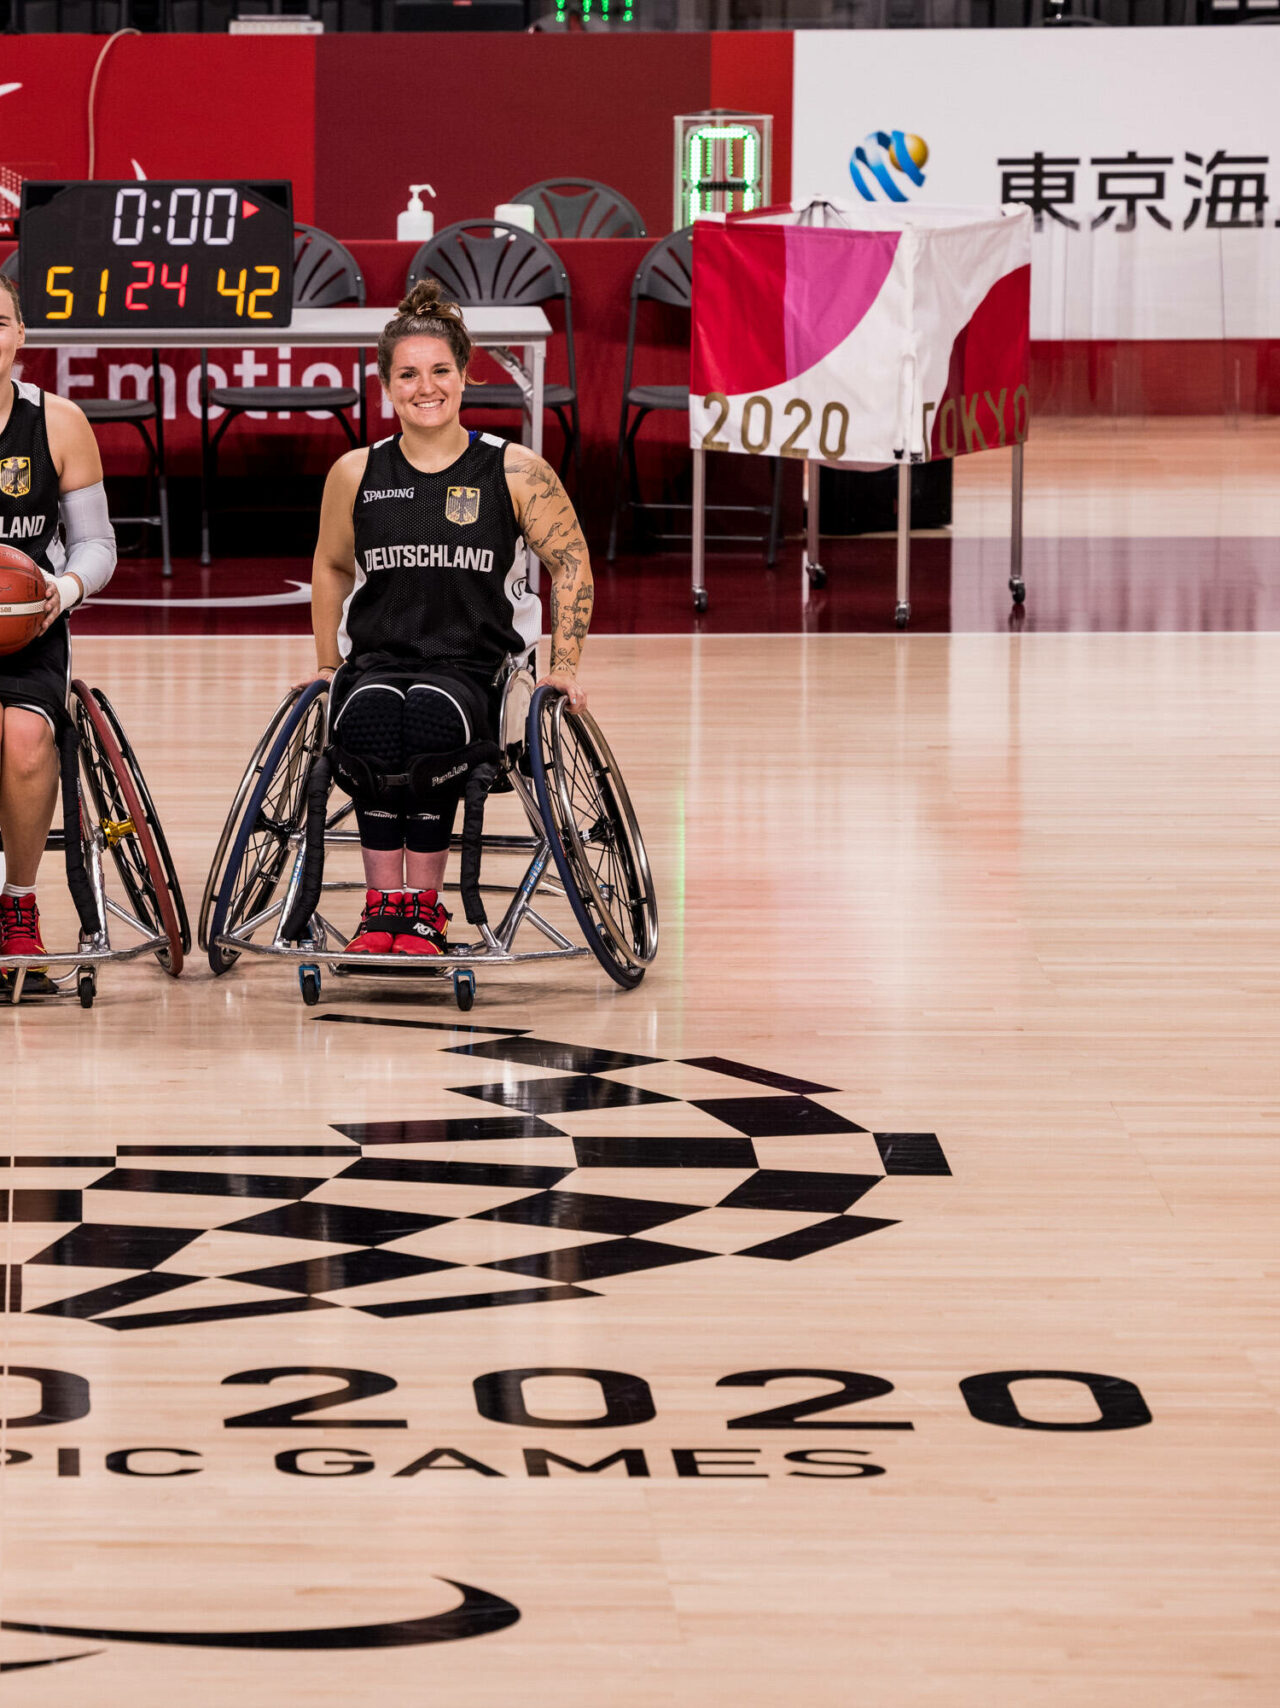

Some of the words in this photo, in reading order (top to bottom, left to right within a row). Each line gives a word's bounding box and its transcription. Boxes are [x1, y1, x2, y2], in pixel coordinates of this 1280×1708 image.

[112, 187, 238, 246] 0:00
[997, 150, 1280, 232] 東京海
[125, 260, 189, 311] 24
[216, 265, 280, 320] 42
[702, 391, 849, 460] 2020
[923, 383, 1030, 462] TOKYO
[363, 487, 415, 503] SPALDING
[363, 544, 494, 573] DEUTSCHLAND
[220, 1365, 1154, 1432] 2020
[273, 1446, 887, 1479] GAMES
